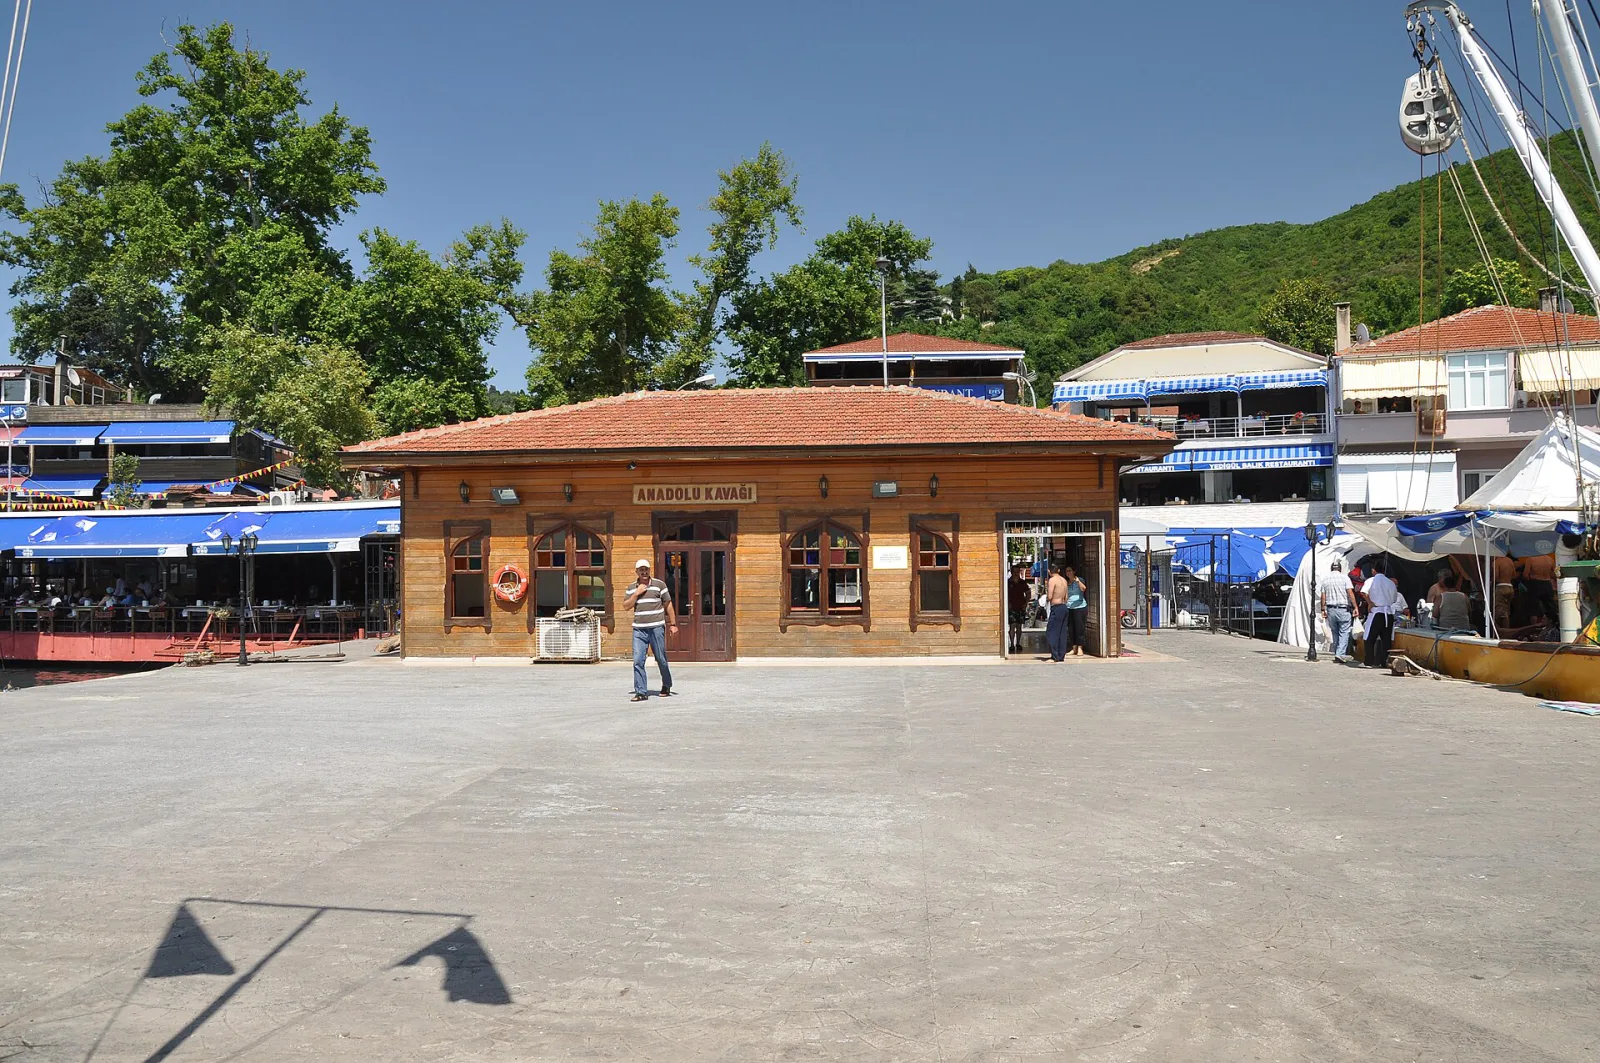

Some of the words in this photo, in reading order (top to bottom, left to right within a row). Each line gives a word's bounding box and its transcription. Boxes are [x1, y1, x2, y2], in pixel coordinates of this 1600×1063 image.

[1242, 461, 1264, 469] BALIK
[1265, 460, 1316, 468] RESTAURANTI
[637, 487, 700, 501] ANADOLU
[704, 483, 752, 501] KAVAĞI
